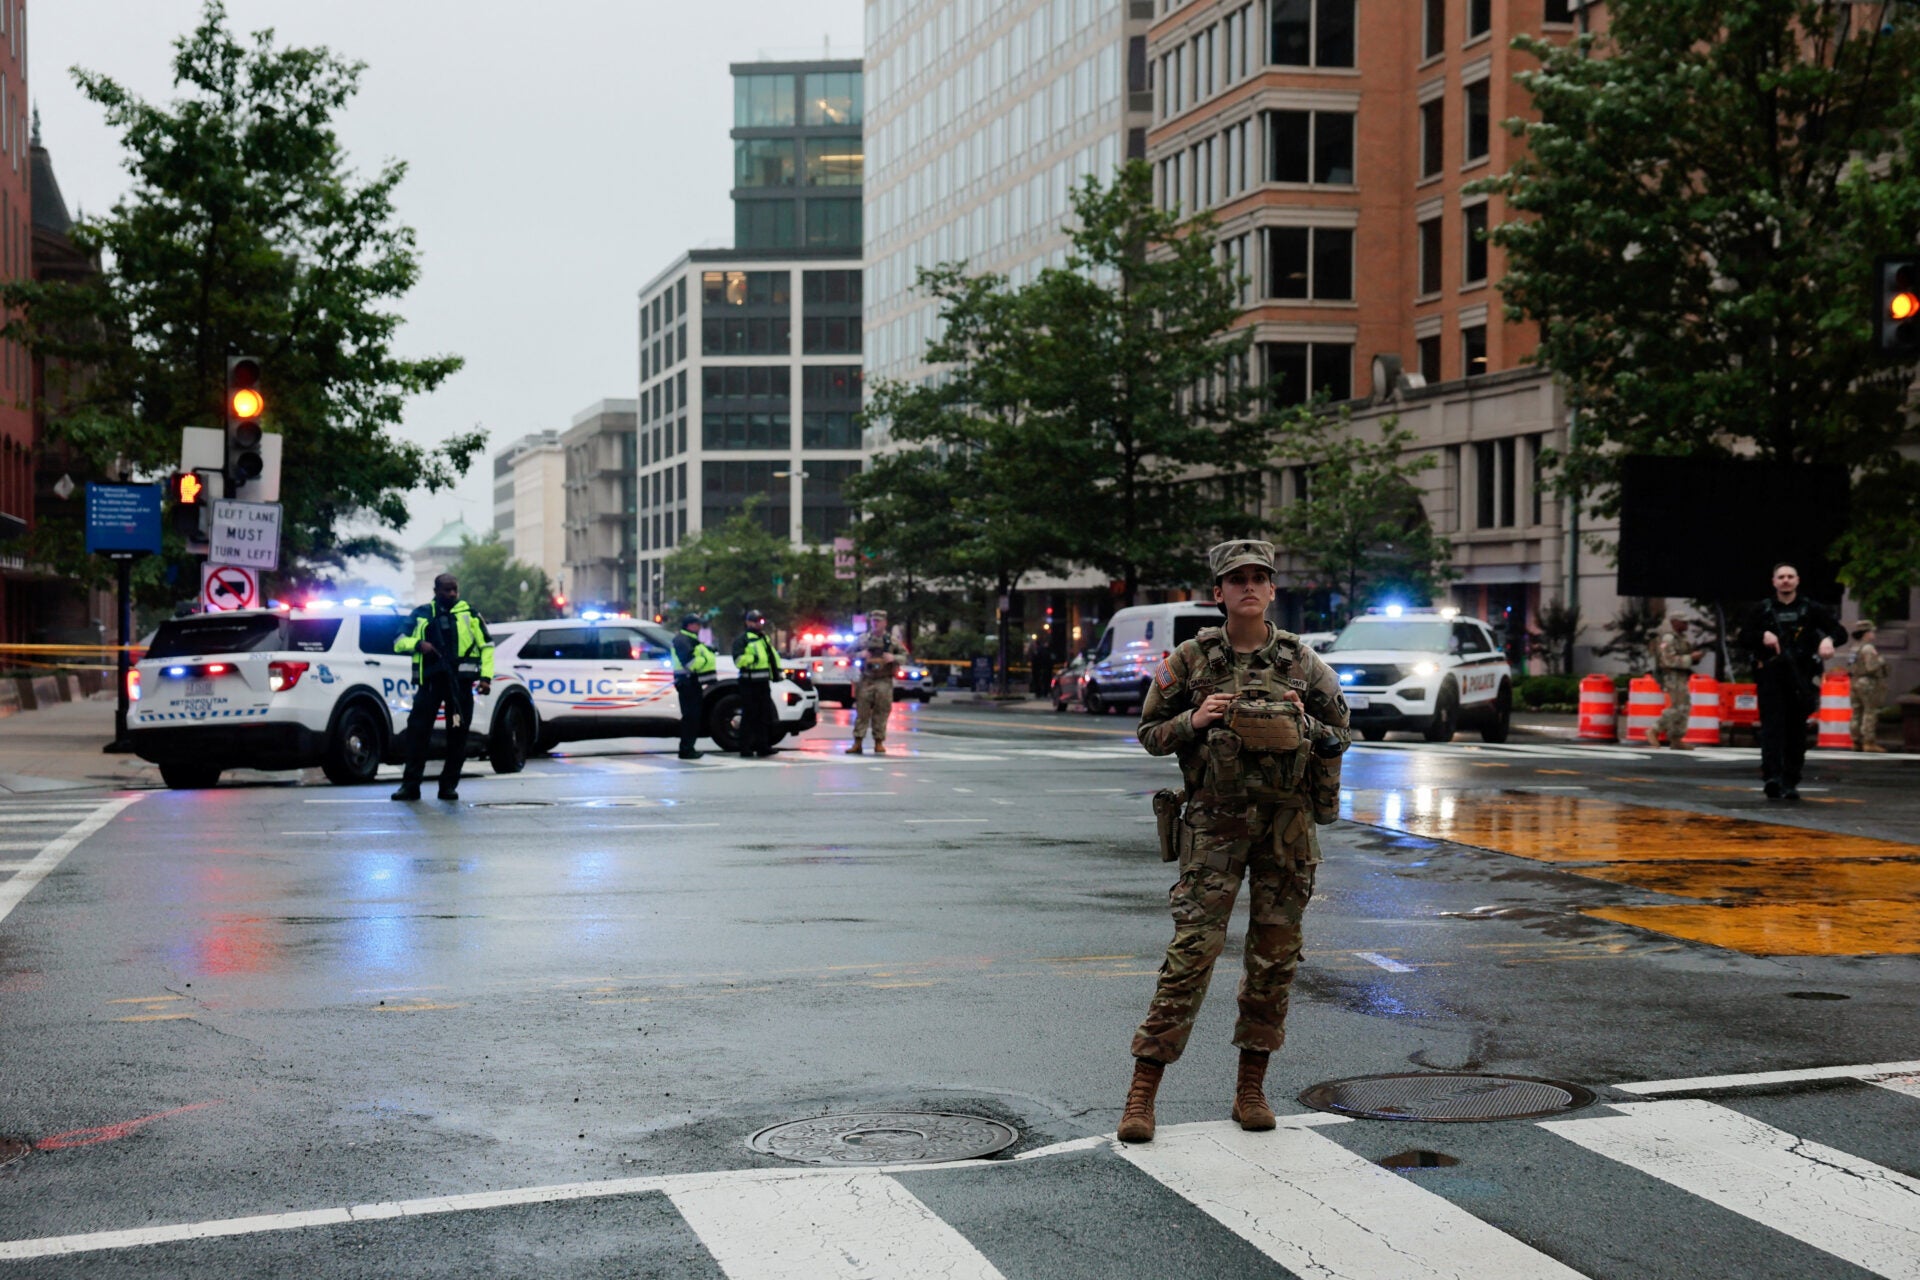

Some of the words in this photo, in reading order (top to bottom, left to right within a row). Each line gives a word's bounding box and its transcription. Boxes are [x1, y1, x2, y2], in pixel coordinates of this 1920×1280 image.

[218, 508, 243, 520] LEFT
[248, 511, 276, 524] LANE
[226, 527, 262, 541] MUST
[215, 545, 241, 557] TURN
[247, 549, 272, 560] LEFT
[528, 679, 633, 694] POLICE
[1469, 672, 1495, 692] POLICE
[170, 698, 228, 706] METROPOLITAN
[184, 702, 212, 711] POLICE
